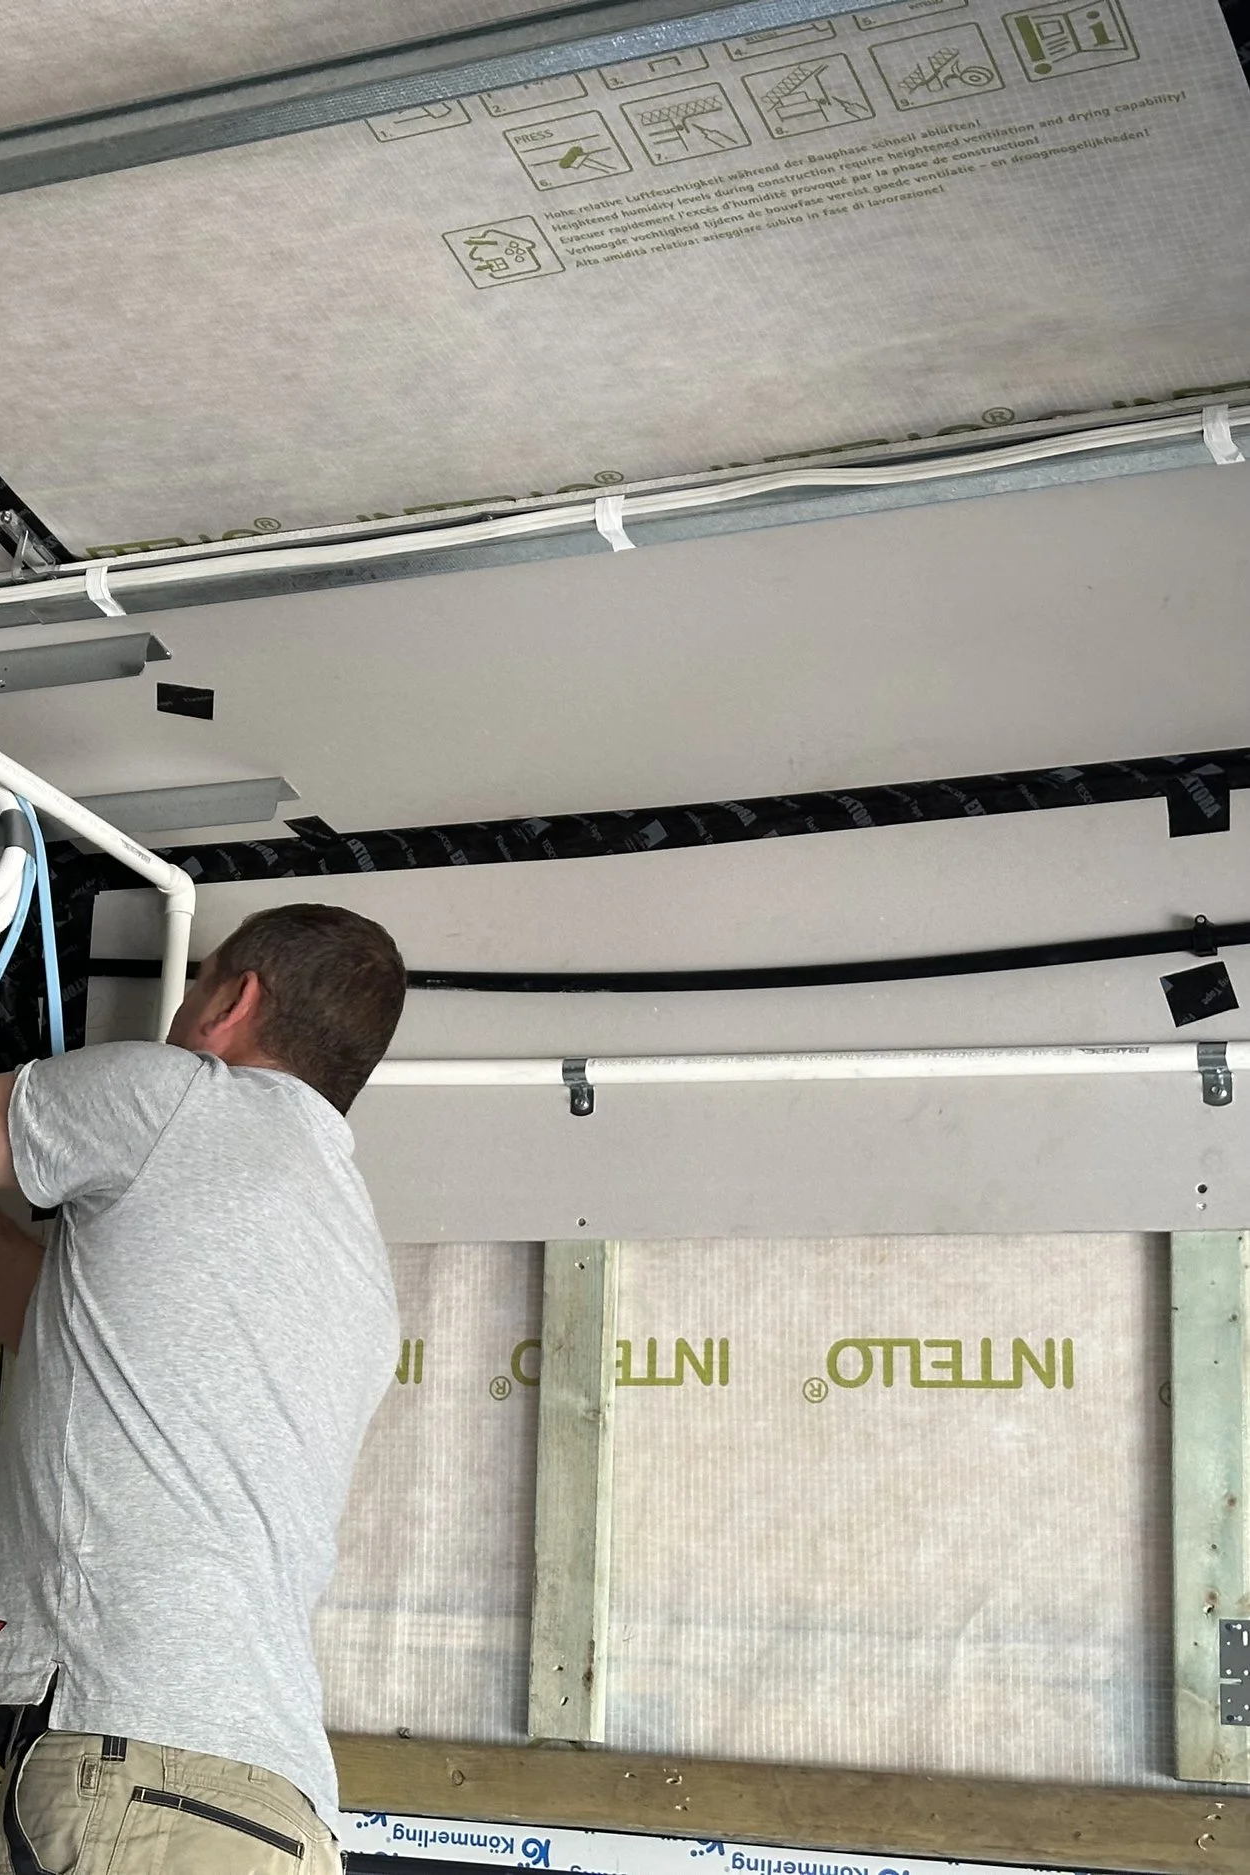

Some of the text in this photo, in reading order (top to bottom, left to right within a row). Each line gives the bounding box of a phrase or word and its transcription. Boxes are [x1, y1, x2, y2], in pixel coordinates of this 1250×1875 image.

[514, 130, 554, 144] PRESS
[544, 119, 981, 220] Hohe relative Luftfeuchtigkeit während der Bauphase schnell ablüften!
[552, 91, 1186, 232] Heightened humidity levels during construction require heightened ventilation and drying capability!
[559, 230, 606, 244] Evacuer
[609, 215, 676, 236] rapidement
[791, 177, 848, 196] provoqué
[852, 171, 871, 184] par
[877, 166, 888, 177] la
[893, 160, 929, 175] phase
[933, 154, 948, 165] de
[952, 137, 1040, 160] construction!
[566, 128, 1150, 255] Verhoogde vochtigheid tijdens de bouwfase vereist goede ventilatie en droogmogelijkheden!
[576, 256, 600, 268] Alta
[650, 238, 699, 254] relativa:
[703, 224, 762, 244] arieggiare
[766, 215, 803, 229] subito
[807, 210, 820, 220] in
[823, 204, 849, 216] fase
[853, 201, 864, 211] di
[869, 185, 945, 207] lavorazione!
[392, 1823, 515, 1855] Kömmerling
